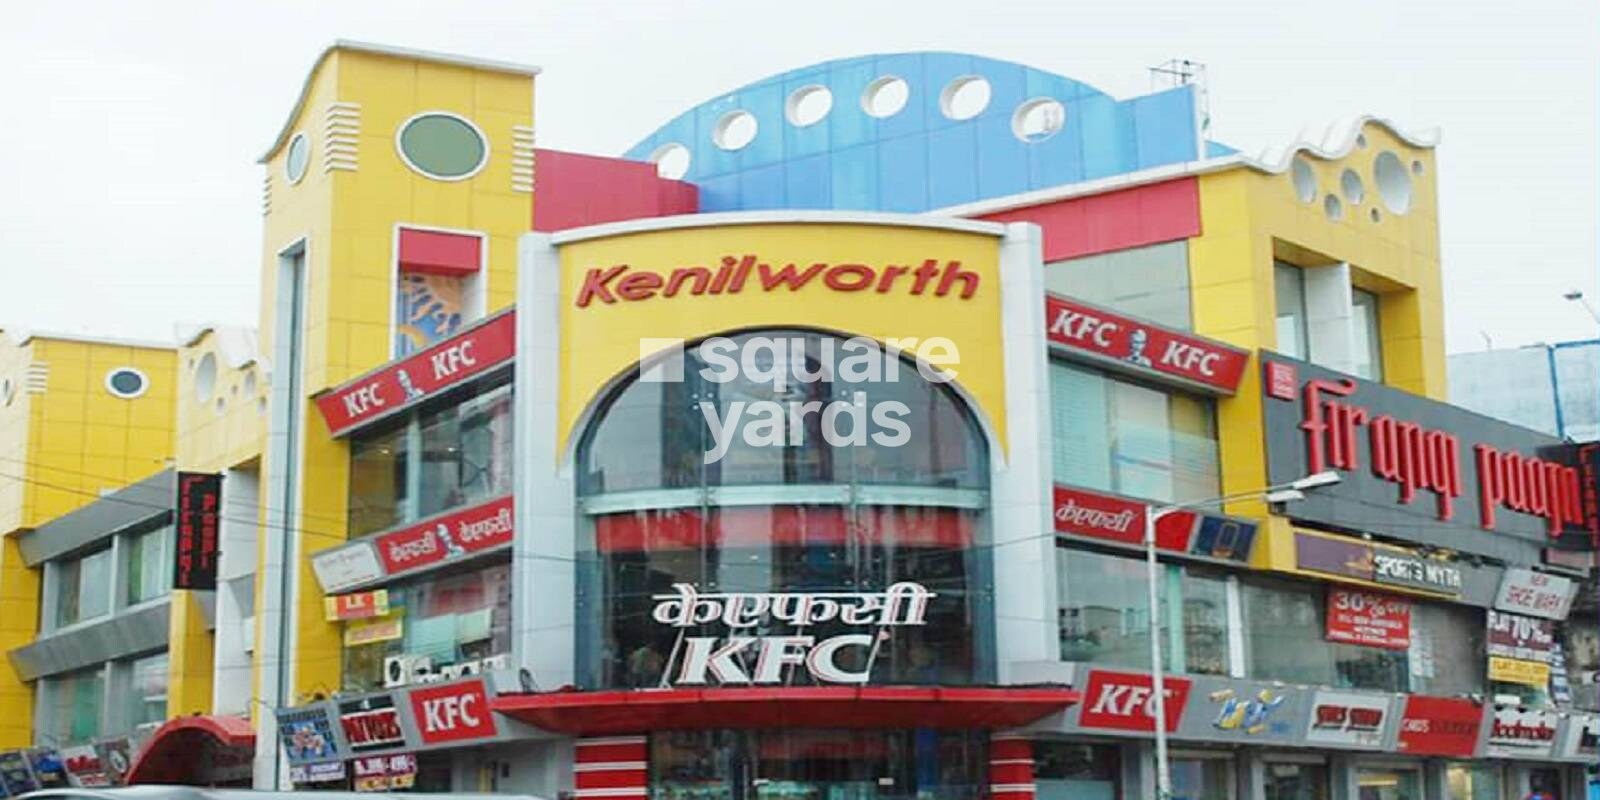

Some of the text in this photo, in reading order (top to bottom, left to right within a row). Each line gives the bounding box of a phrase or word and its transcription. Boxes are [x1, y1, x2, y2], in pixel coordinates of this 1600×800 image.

[575, 254, 981, 308] Kenilworth
[1050, 309, 1117, 348] KFC
[431, 340, 476, 380] KFC
[1160, 340, 1220, 376] KFC
[343, 383, 385, 417] KFC
[652, 580, 938, 627] केएफसी
[676, 635, 873, 685] KFC
[422, 693, 480, 733] KFC
